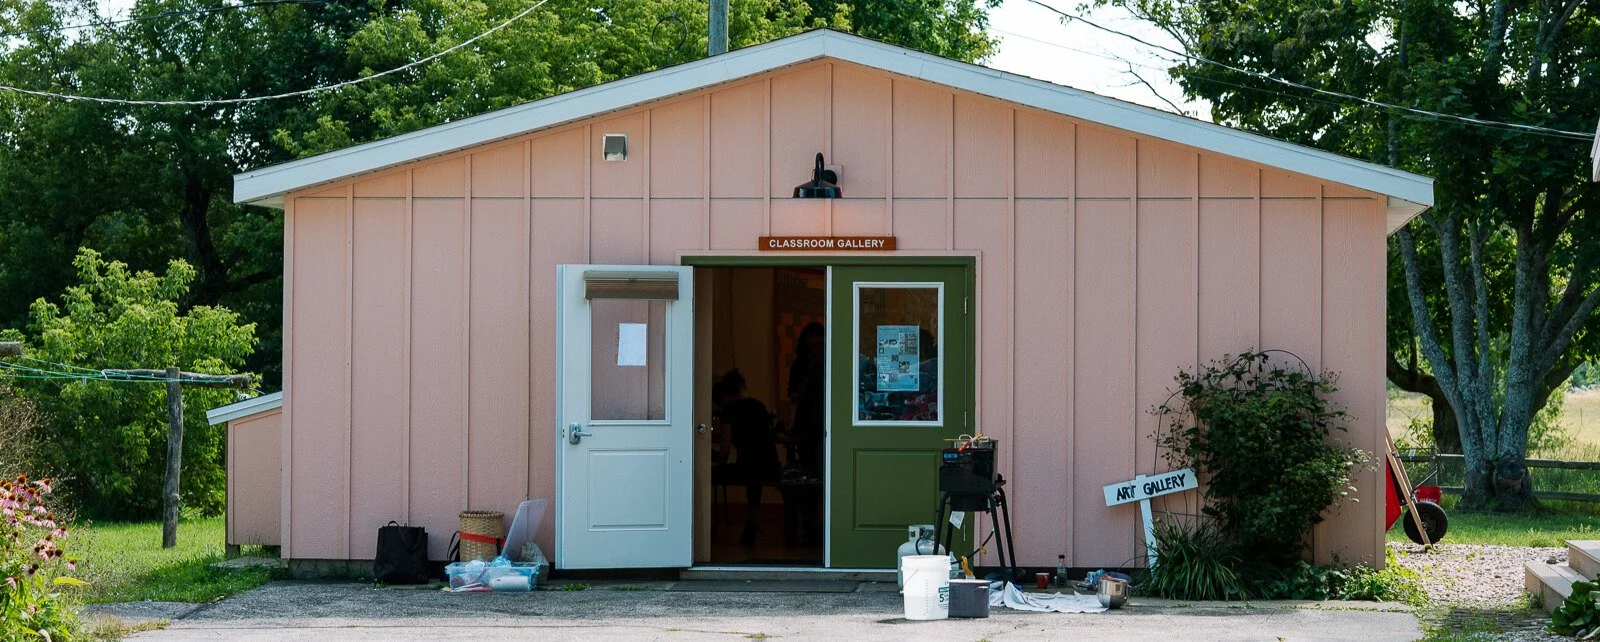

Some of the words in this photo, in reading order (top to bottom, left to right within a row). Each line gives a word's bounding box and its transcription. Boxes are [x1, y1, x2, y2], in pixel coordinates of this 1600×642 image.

[769, 239, 834, 248] CLASSROOM
[837, 239, 885, 248] GALLERY
[1116, 485, 1136, 501] ART
[1143, 473, 1185, 495] GALLERY
[939, 594, 945, 602] 5
